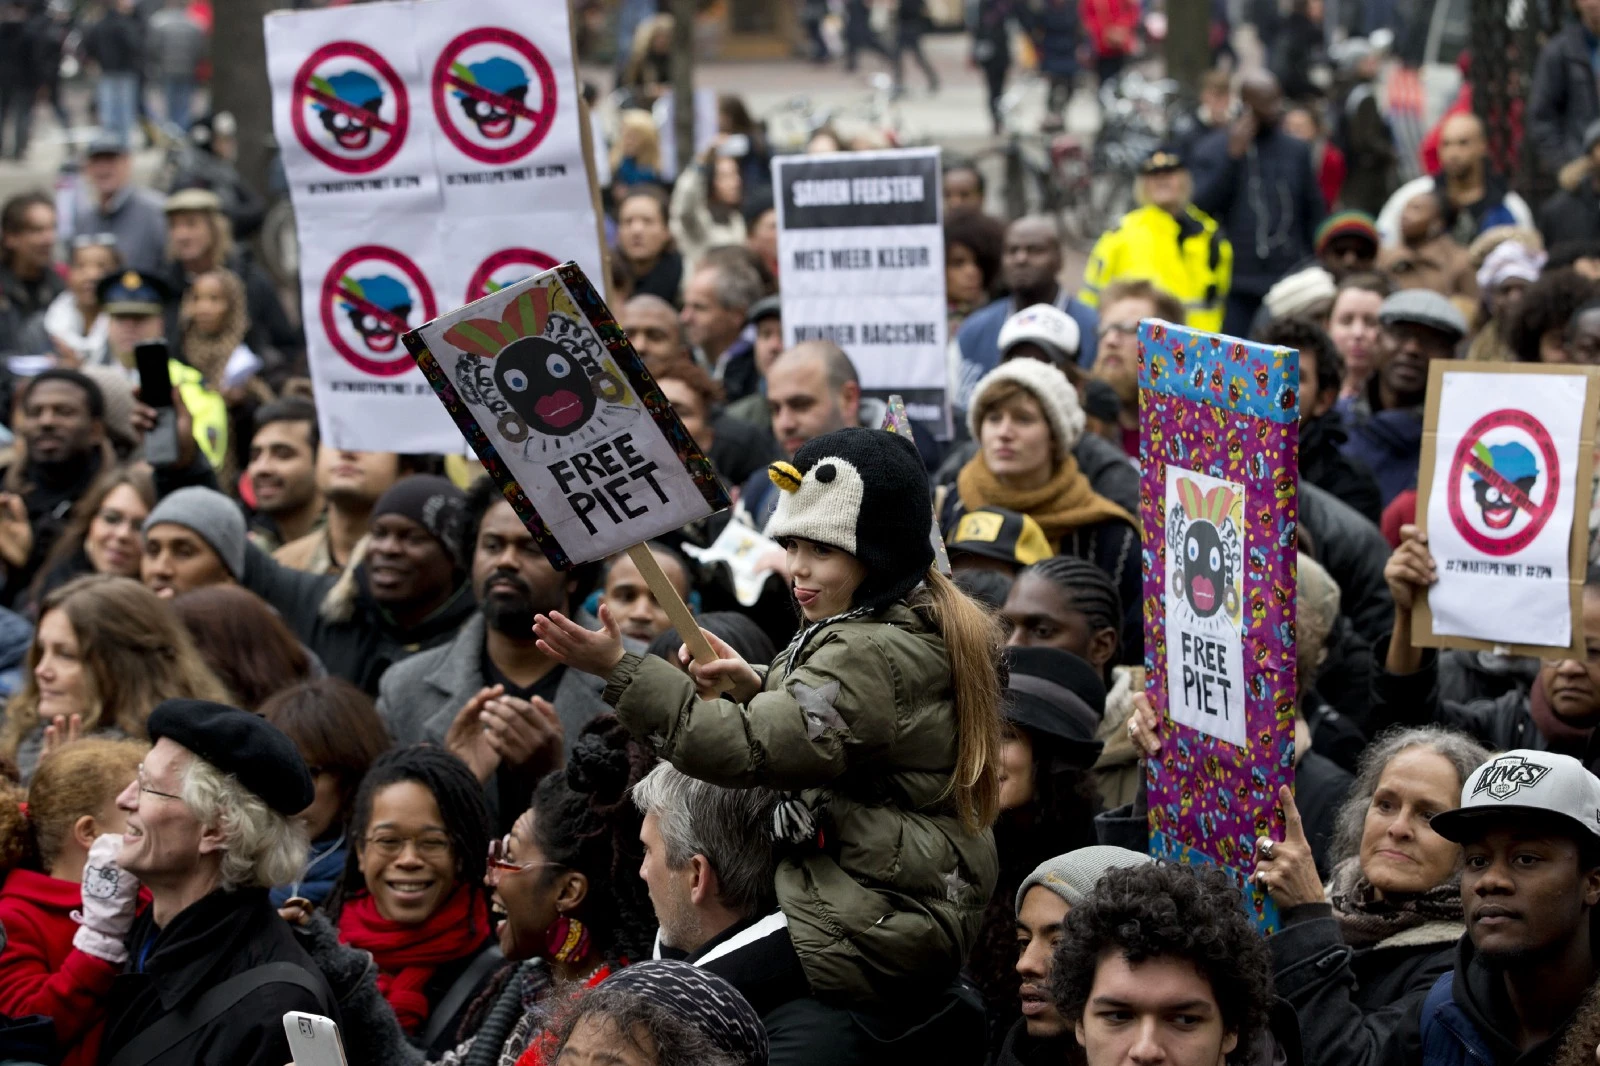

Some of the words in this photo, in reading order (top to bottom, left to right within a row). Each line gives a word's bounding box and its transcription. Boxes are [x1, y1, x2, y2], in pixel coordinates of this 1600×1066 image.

[792, 178, 850, 207] SAMEN
[852, 175, 924, 204] FEESTEN
[794, 250, 824, 270] MET
[830, 248, 870, 269] MEER
[878, 246, 928, 268] KLEUR
[861, 322, 937, 344] RACISME
[547, 432, 645, 494] FREE
[567, 461, 669, 536] PIET
[1181, 631, 1227, 675] FREE
[1182, 664, 1231, 720] PIET
[1475, 764, 1543, 790] KINGS
